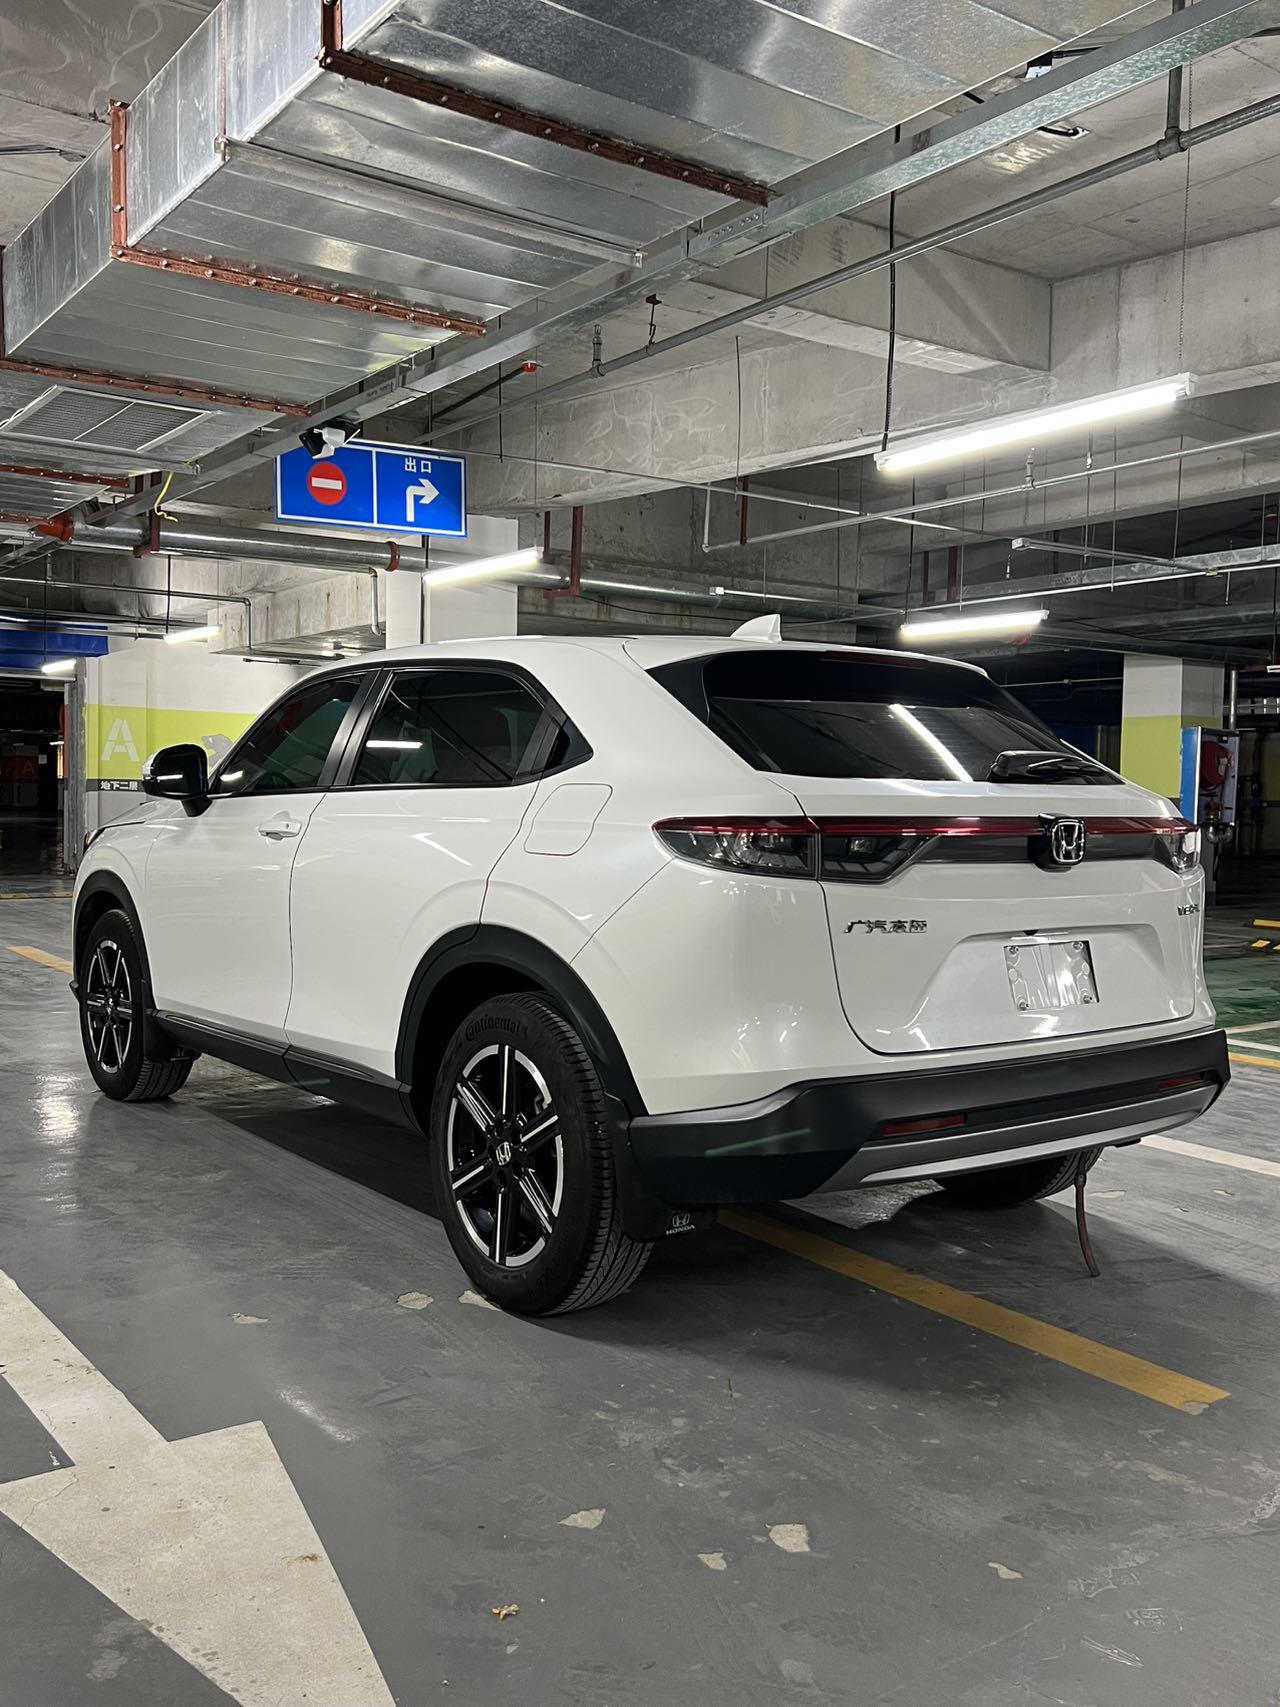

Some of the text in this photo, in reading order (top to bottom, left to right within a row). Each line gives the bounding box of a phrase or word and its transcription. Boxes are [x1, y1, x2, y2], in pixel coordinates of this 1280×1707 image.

[405, 457, 431, 473] 出口
[101, 719, 139, 761] A
[465, 1013, 521, 1041] Continental
[665, 1225, 695, 1235] HONDA
